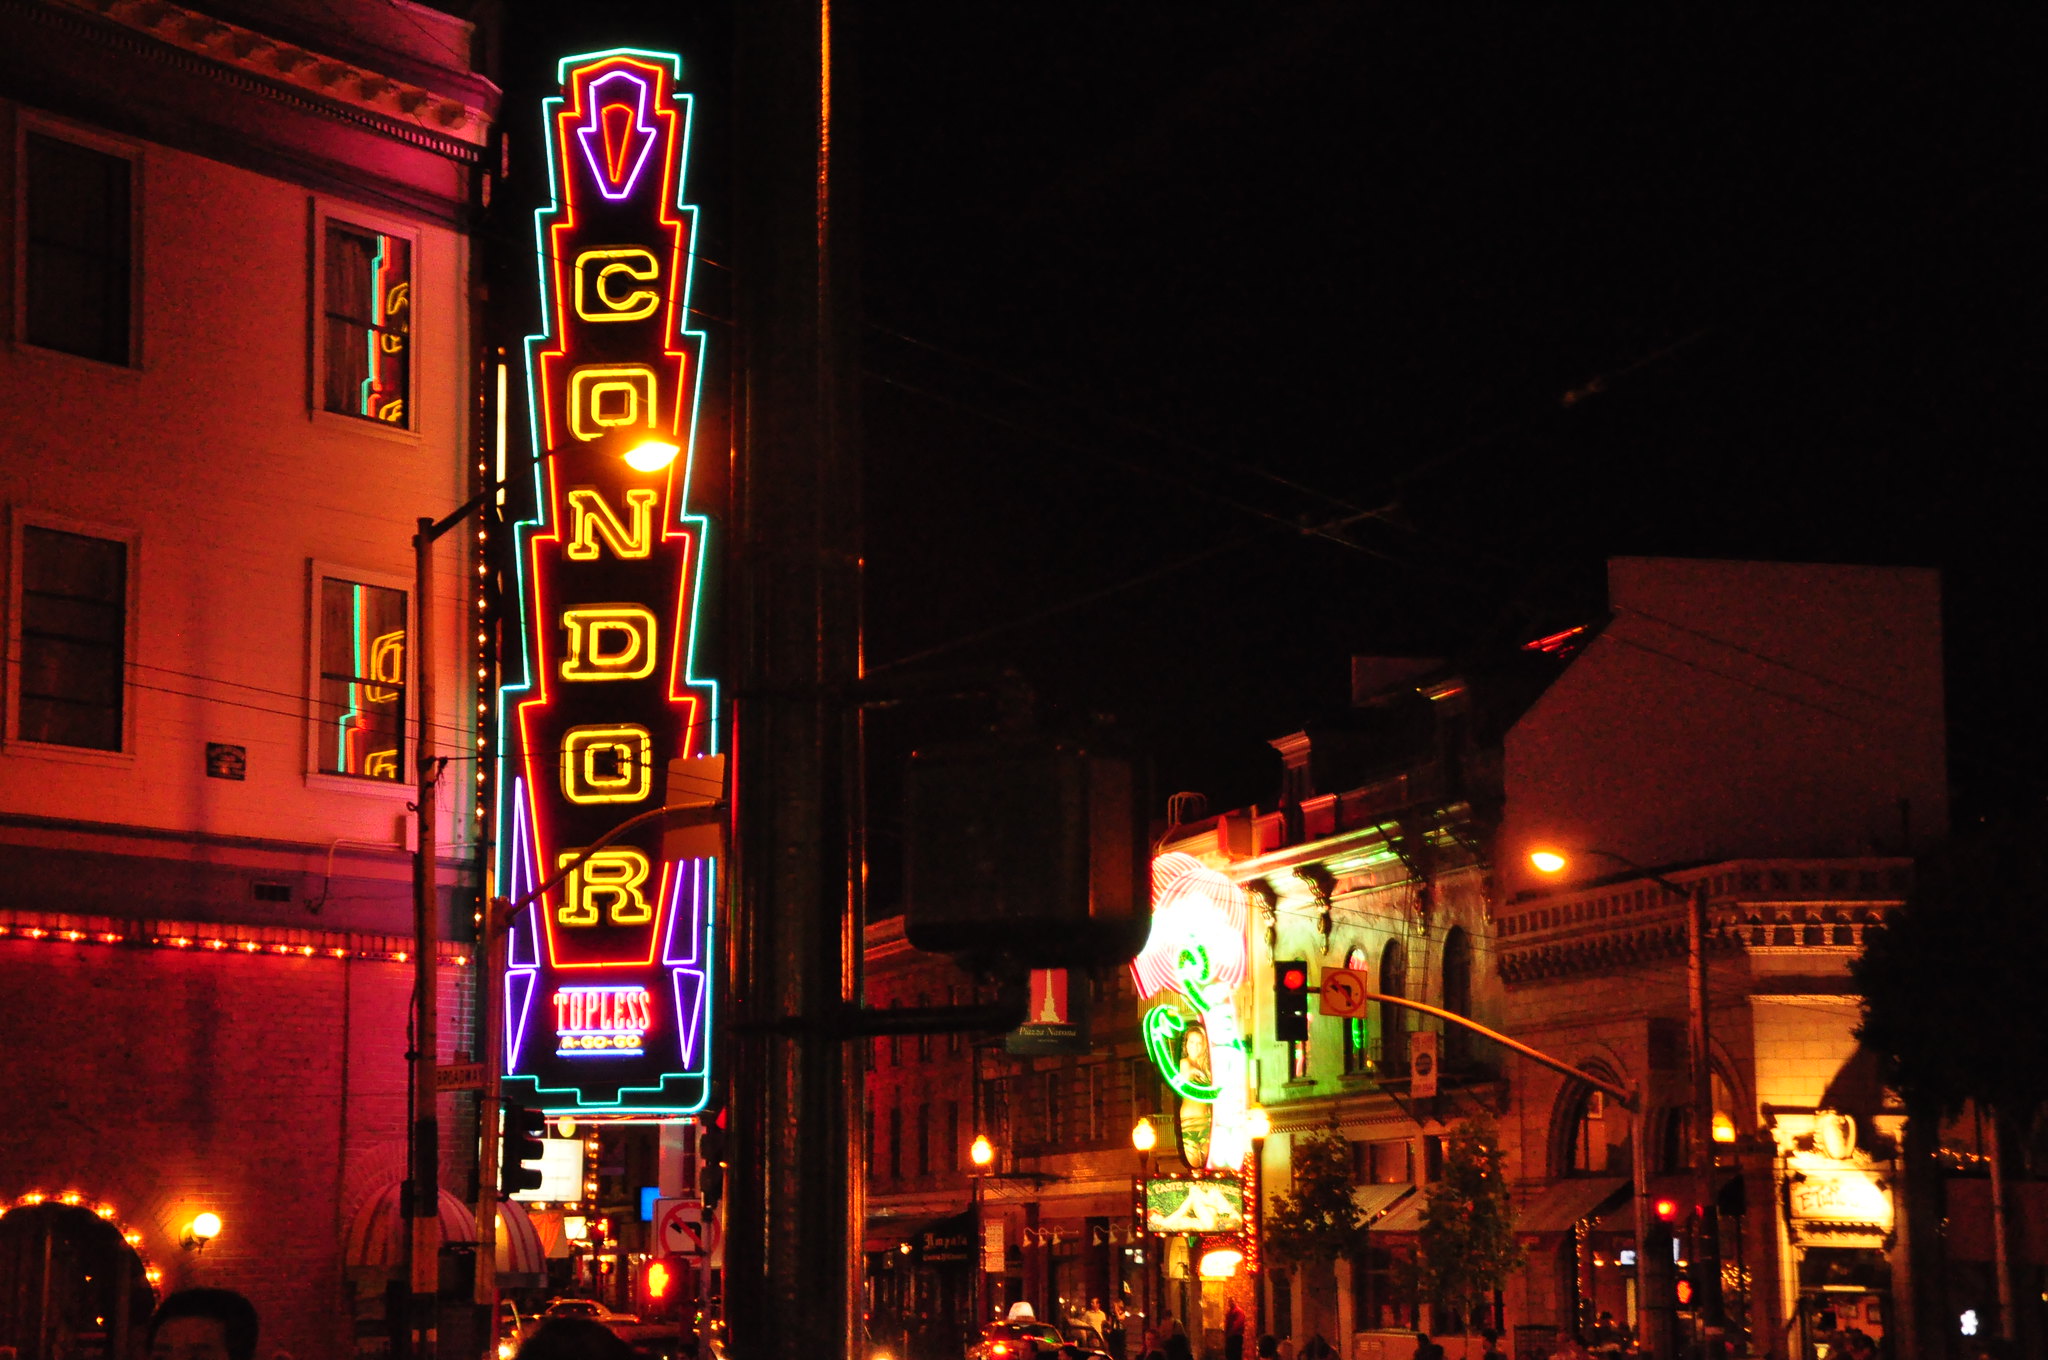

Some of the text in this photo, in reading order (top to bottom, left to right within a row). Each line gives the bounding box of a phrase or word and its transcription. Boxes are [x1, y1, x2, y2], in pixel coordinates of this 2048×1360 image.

[556, 246, 661, 926] CONDOR
[553, 991, 651, 1031] TOPLESS
[560, 1035, 641, 1049] A-GO-GO
[437, 1069, 482, 1086] BROADWAY
[1152, 1181, 1184, 1195] TASTE
